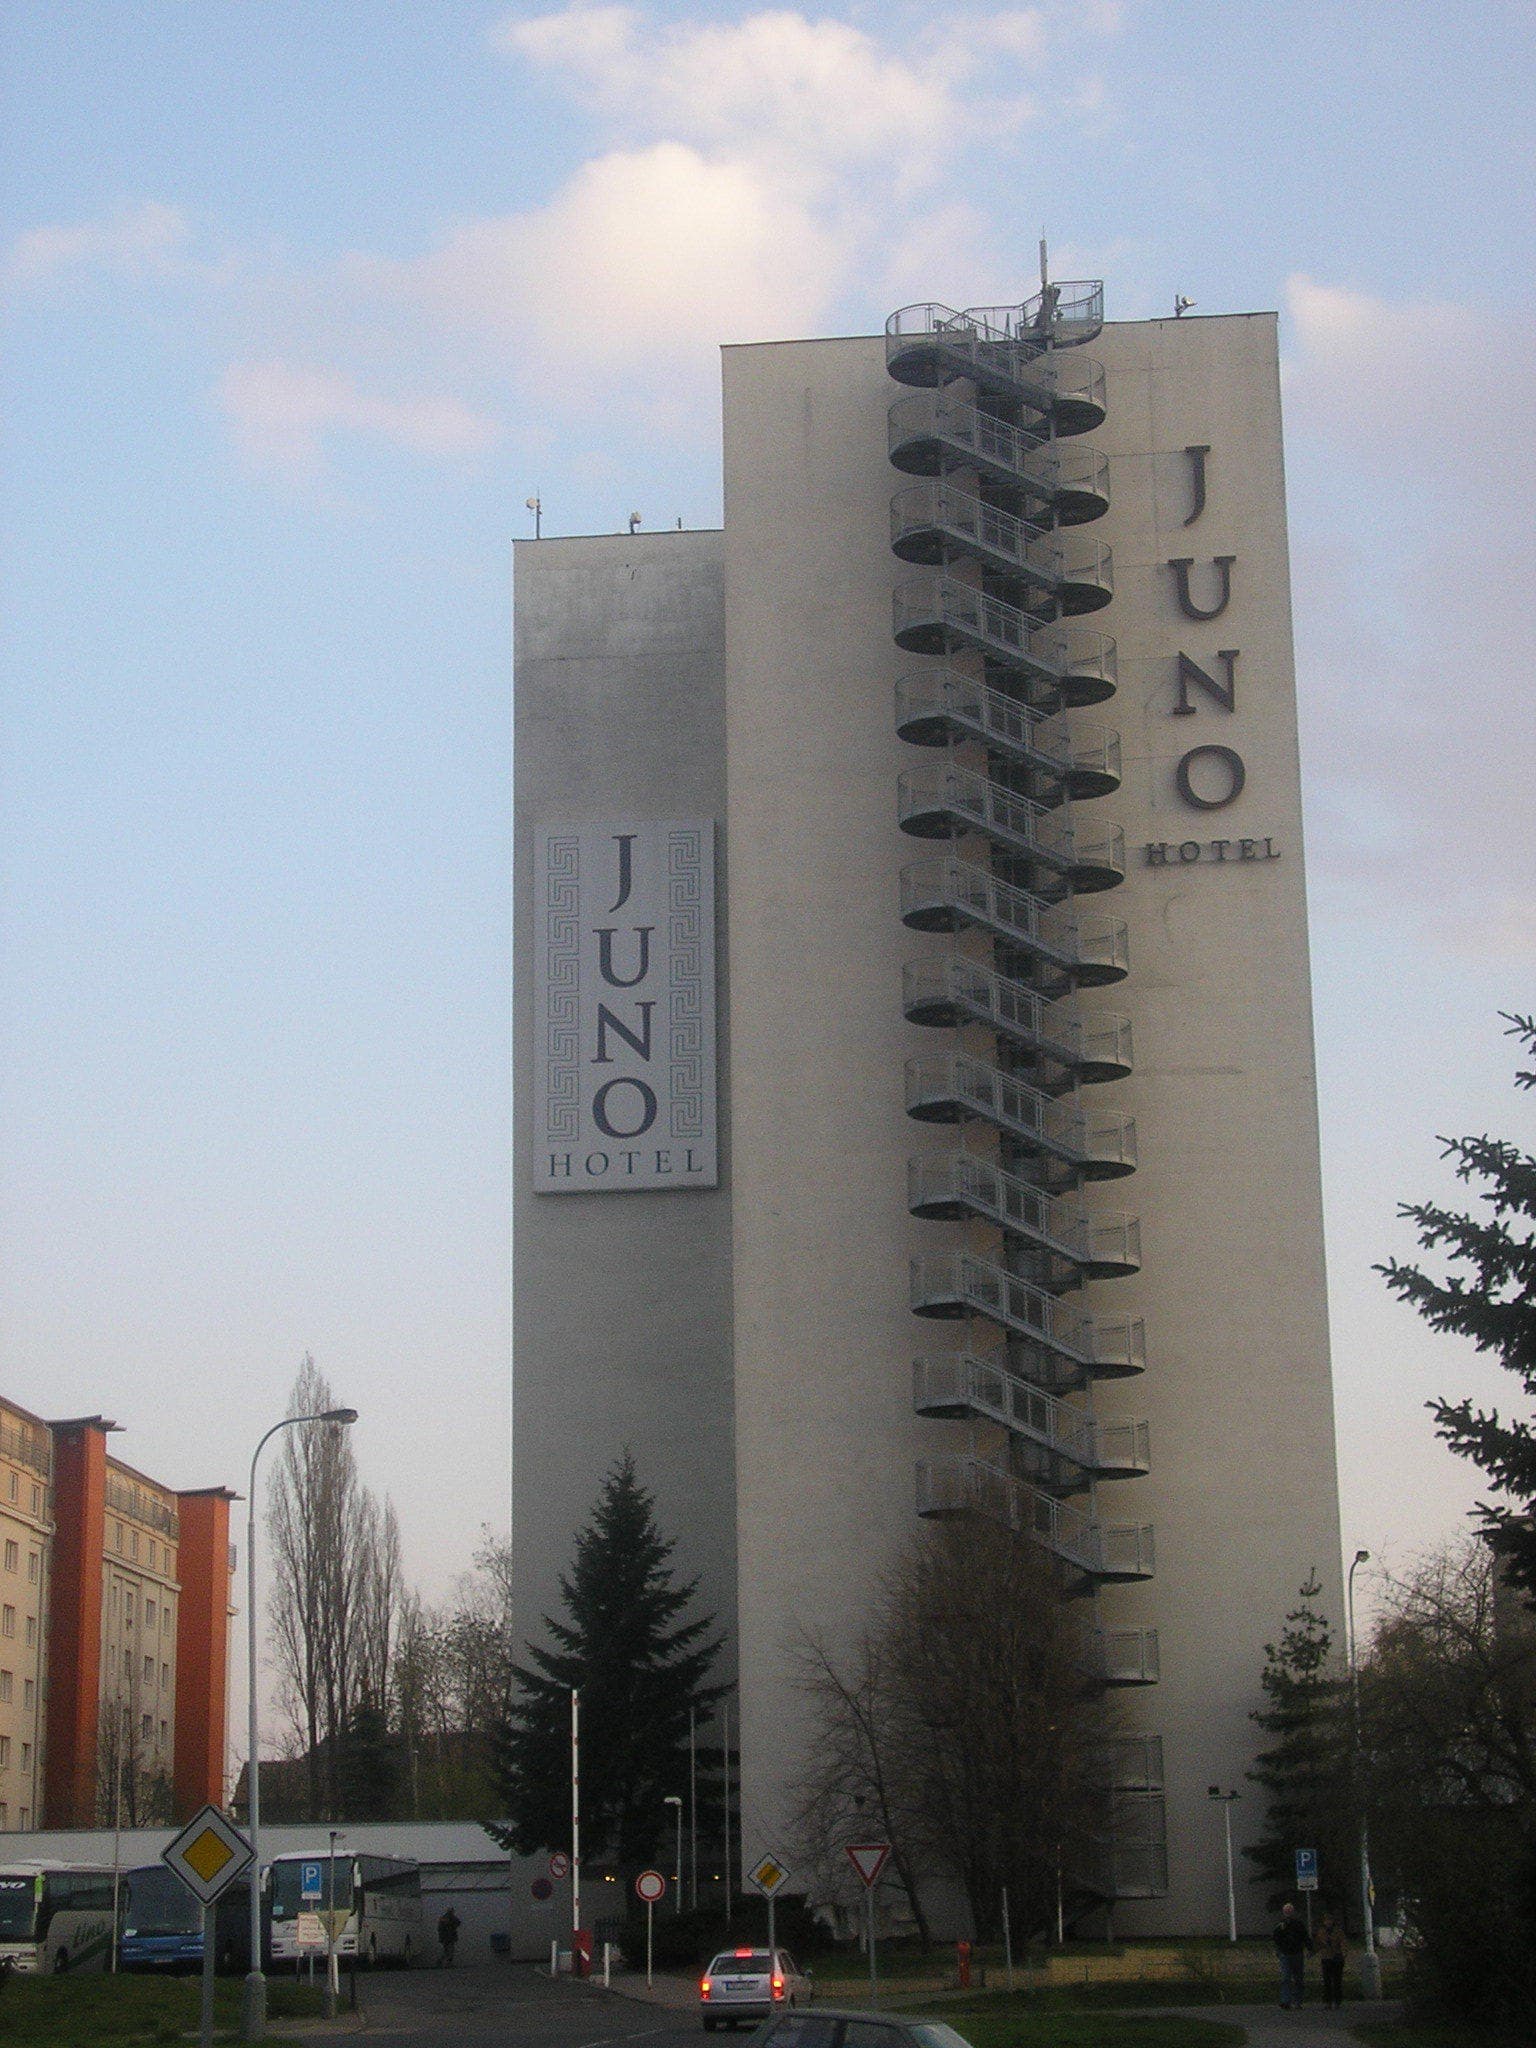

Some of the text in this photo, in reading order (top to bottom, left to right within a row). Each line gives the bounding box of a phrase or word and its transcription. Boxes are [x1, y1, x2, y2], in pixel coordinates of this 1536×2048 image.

[1168, 445, 1246, 810] JUNO
[1146, 837, 1281, 866] HOTEL
[590, 834, 657, 1139] JUNO
[547, 1149, 703, 1177] HOTEL
[1301, 1852, 1311, 1867] P
[305, 1867, 317, 1884] P
